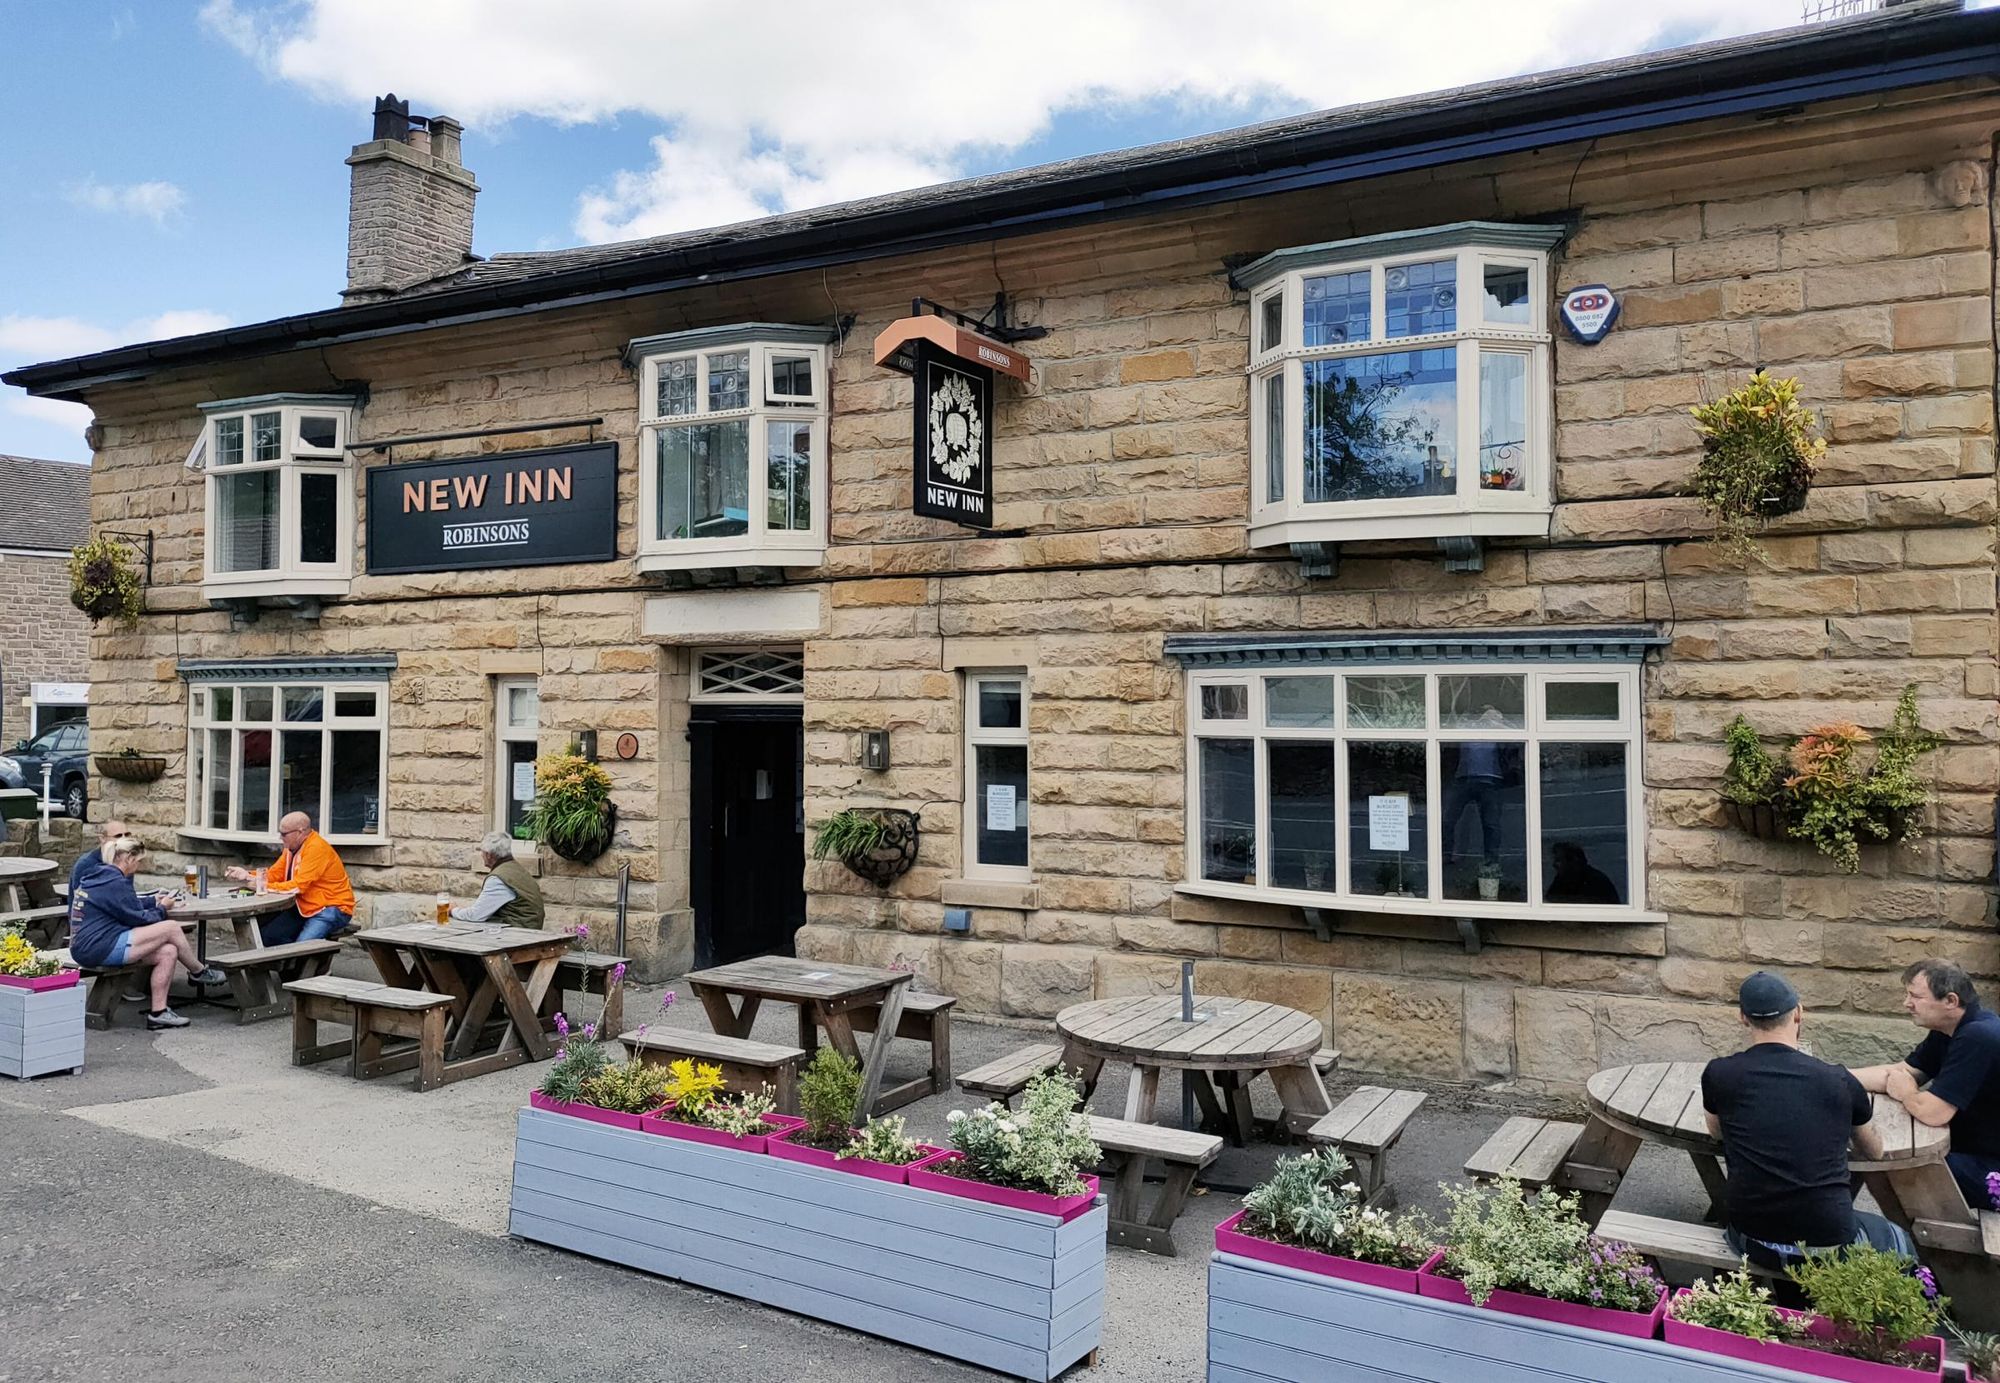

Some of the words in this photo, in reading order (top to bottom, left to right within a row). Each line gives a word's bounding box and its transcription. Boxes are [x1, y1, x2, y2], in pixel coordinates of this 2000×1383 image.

[978, 346, 1011, 368] ROBINSONS
[402, 474, 489, 514] NEW
[504, 466, 572, 504] INN
[927, 487, 958, 509] NEW
[962, 493, 984, 513] INN
[443, 523, 530, 546] ROBINSONS
